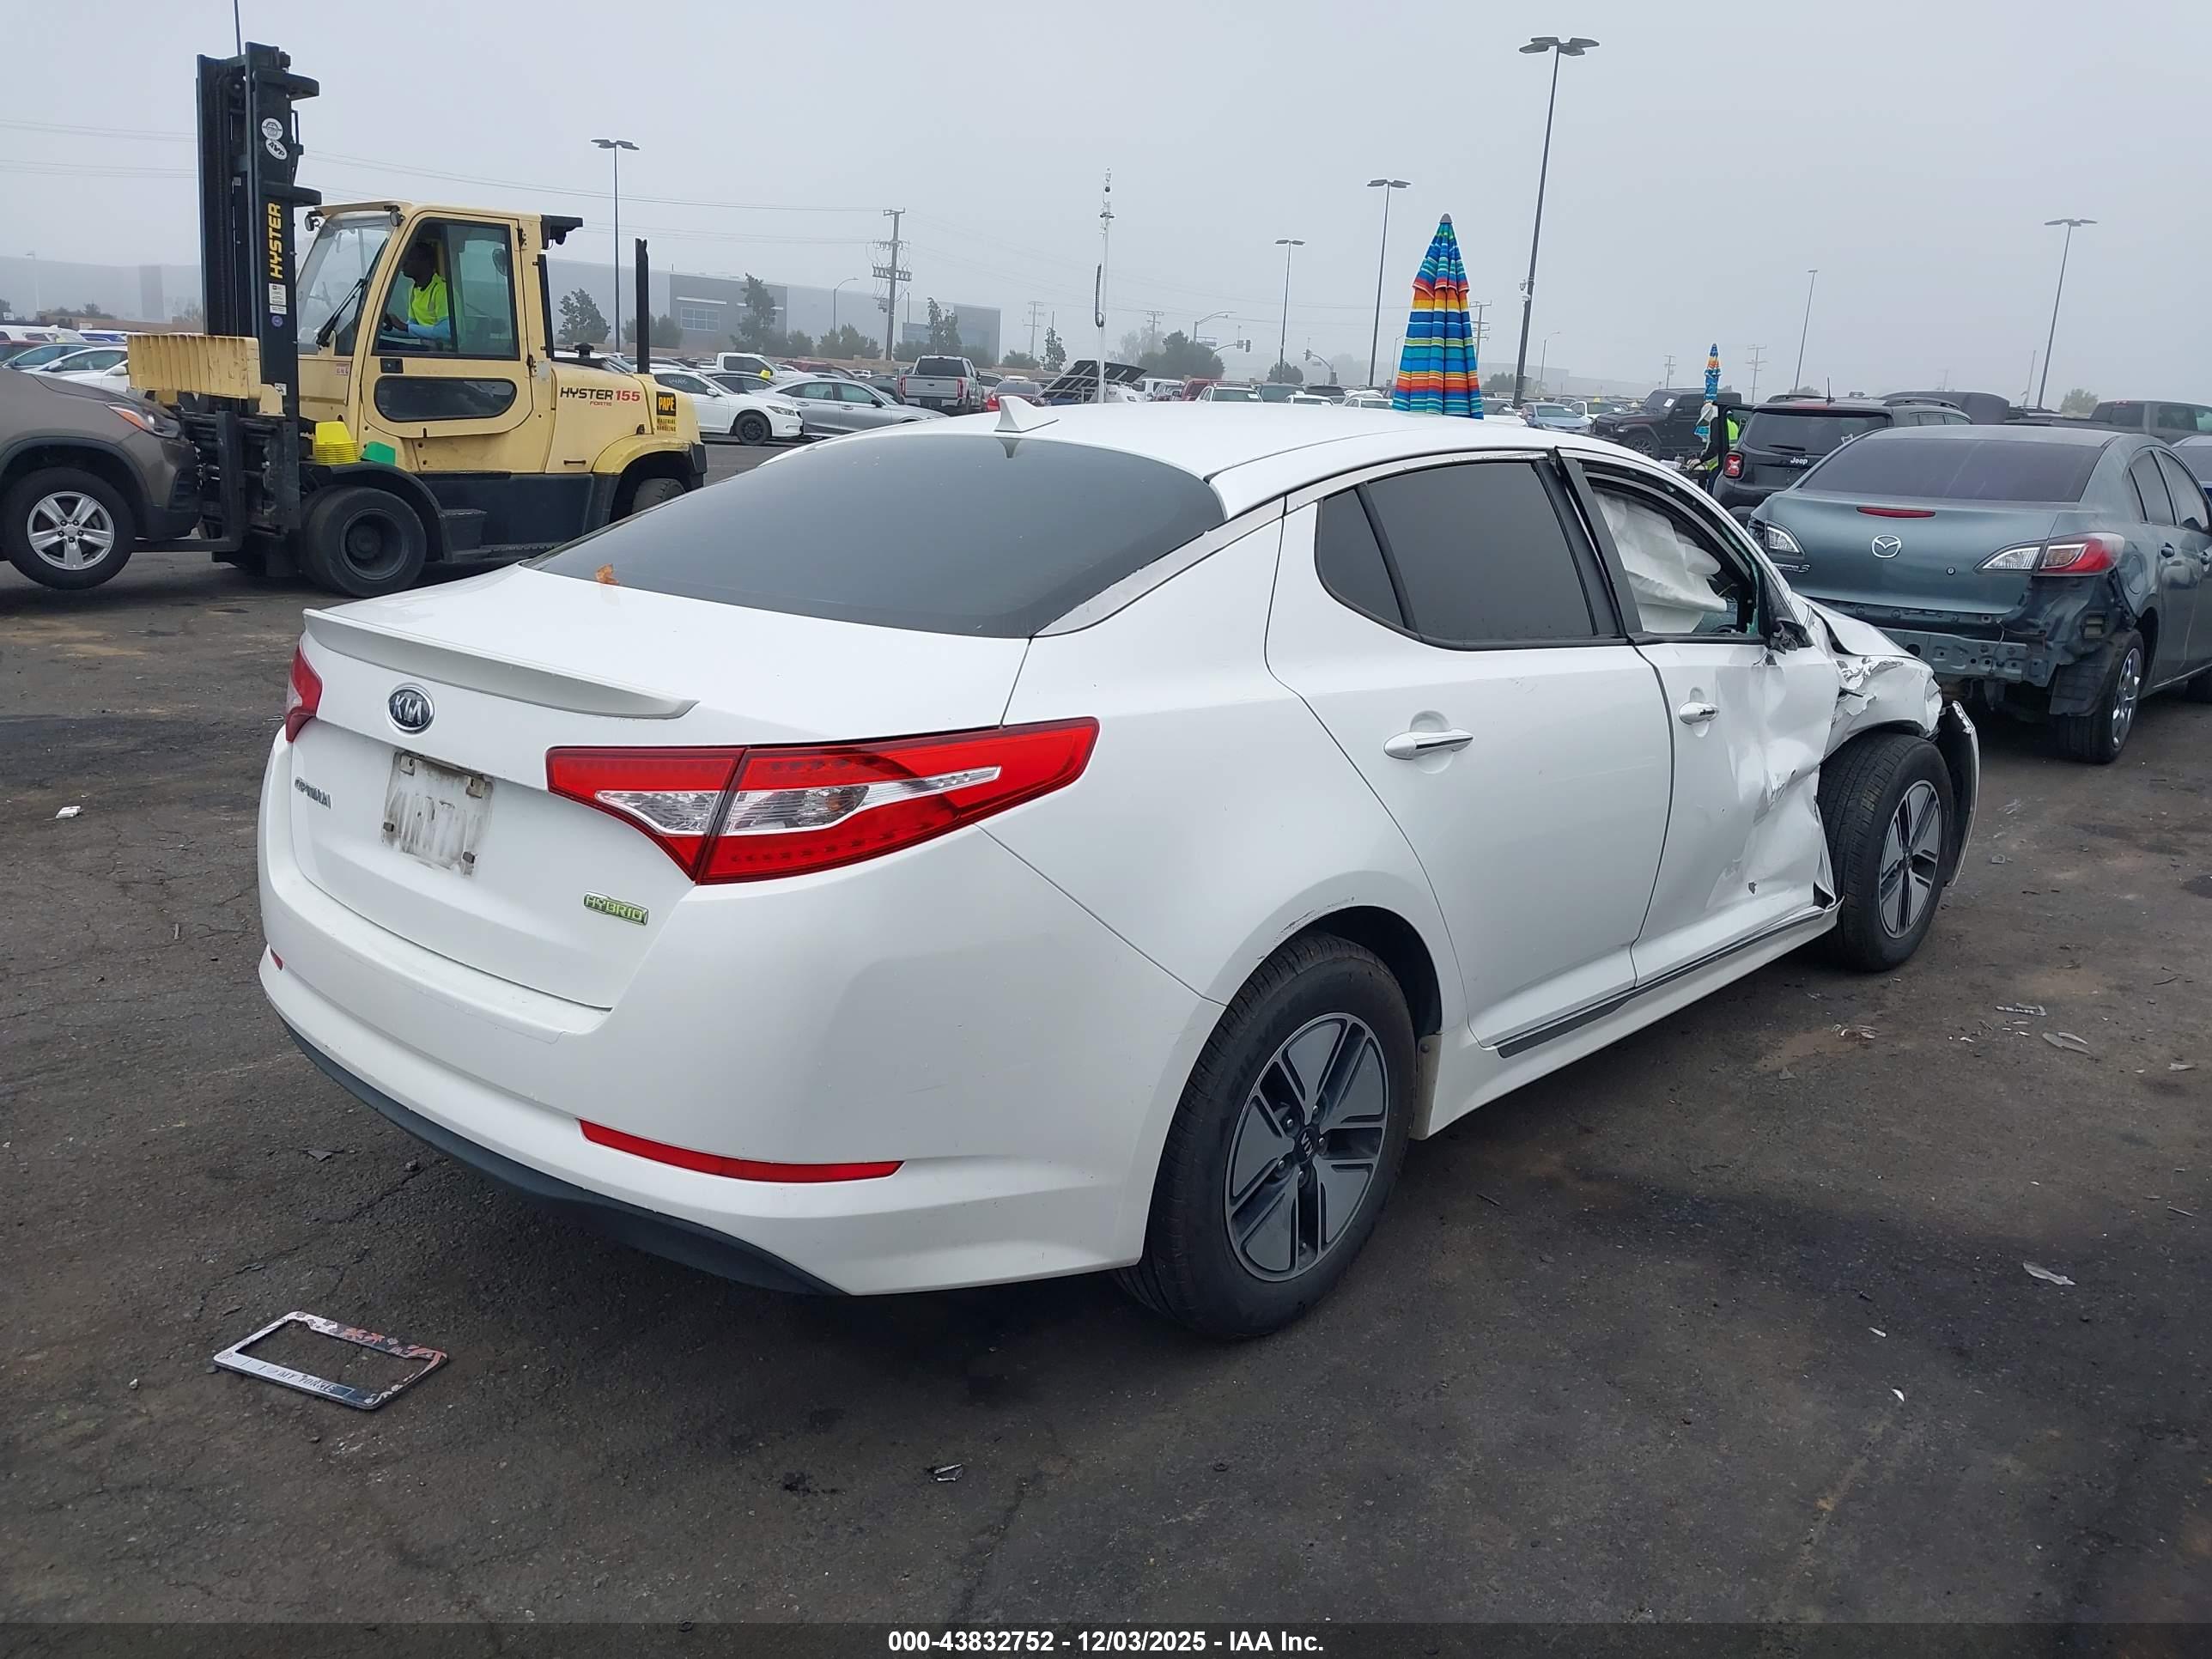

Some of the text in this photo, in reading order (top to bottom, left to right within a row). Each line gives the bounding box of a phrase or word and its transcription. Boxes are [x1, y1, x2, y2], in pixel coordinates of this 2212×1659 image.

[268, 202, 283, 279] HYSTER
[560, 386, 641, 402] HYSTER 155
[1790, 457, 1808, 465] Jeep
[392, 695, 422, 725] KIA
[585, 895, 644, 922] HYBRID
[1300, 1132, 1314, 1158] KIA
